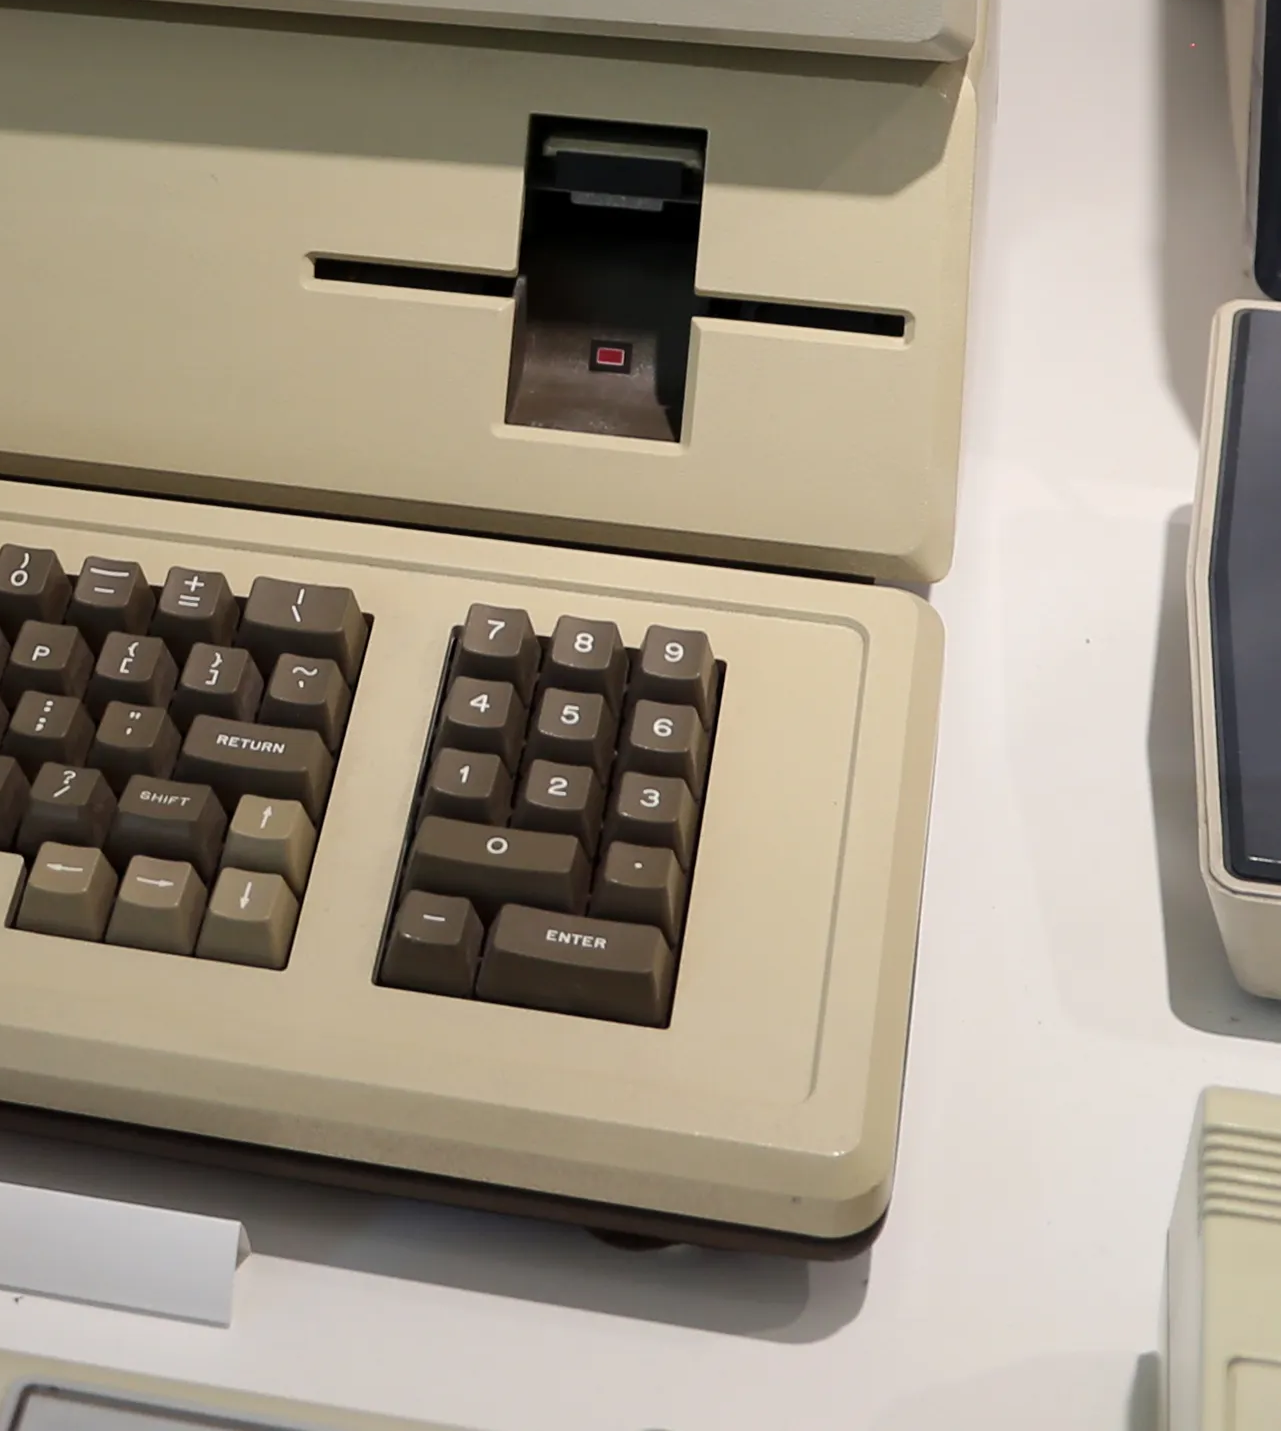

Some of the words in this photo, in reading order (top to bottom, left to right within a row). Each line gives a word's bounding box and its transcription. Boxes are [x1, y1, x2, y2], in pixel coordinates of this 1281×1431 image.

[10, 569, 28, 587] 0
[487, 619, 506, 640] 7
[574, 633, 593, 653] 8
[664, 642, 684, 663] 9
[31, 645, 51, 661] P
[469, 694, 490, 713] 4
[560, 705, 580, 725] 5
[653, 718, 673, 737] 6
[216, 734, 285, 754] RETURN
[459, 765, 470, 783] 1
[547, 777, 568, 796] 2
[139, 790, 191, 807] SHIFT
[639, 789, 660, 808] 3
[486, 837, 508, 854] 0
[545, 929, 607, 949] ENTER
